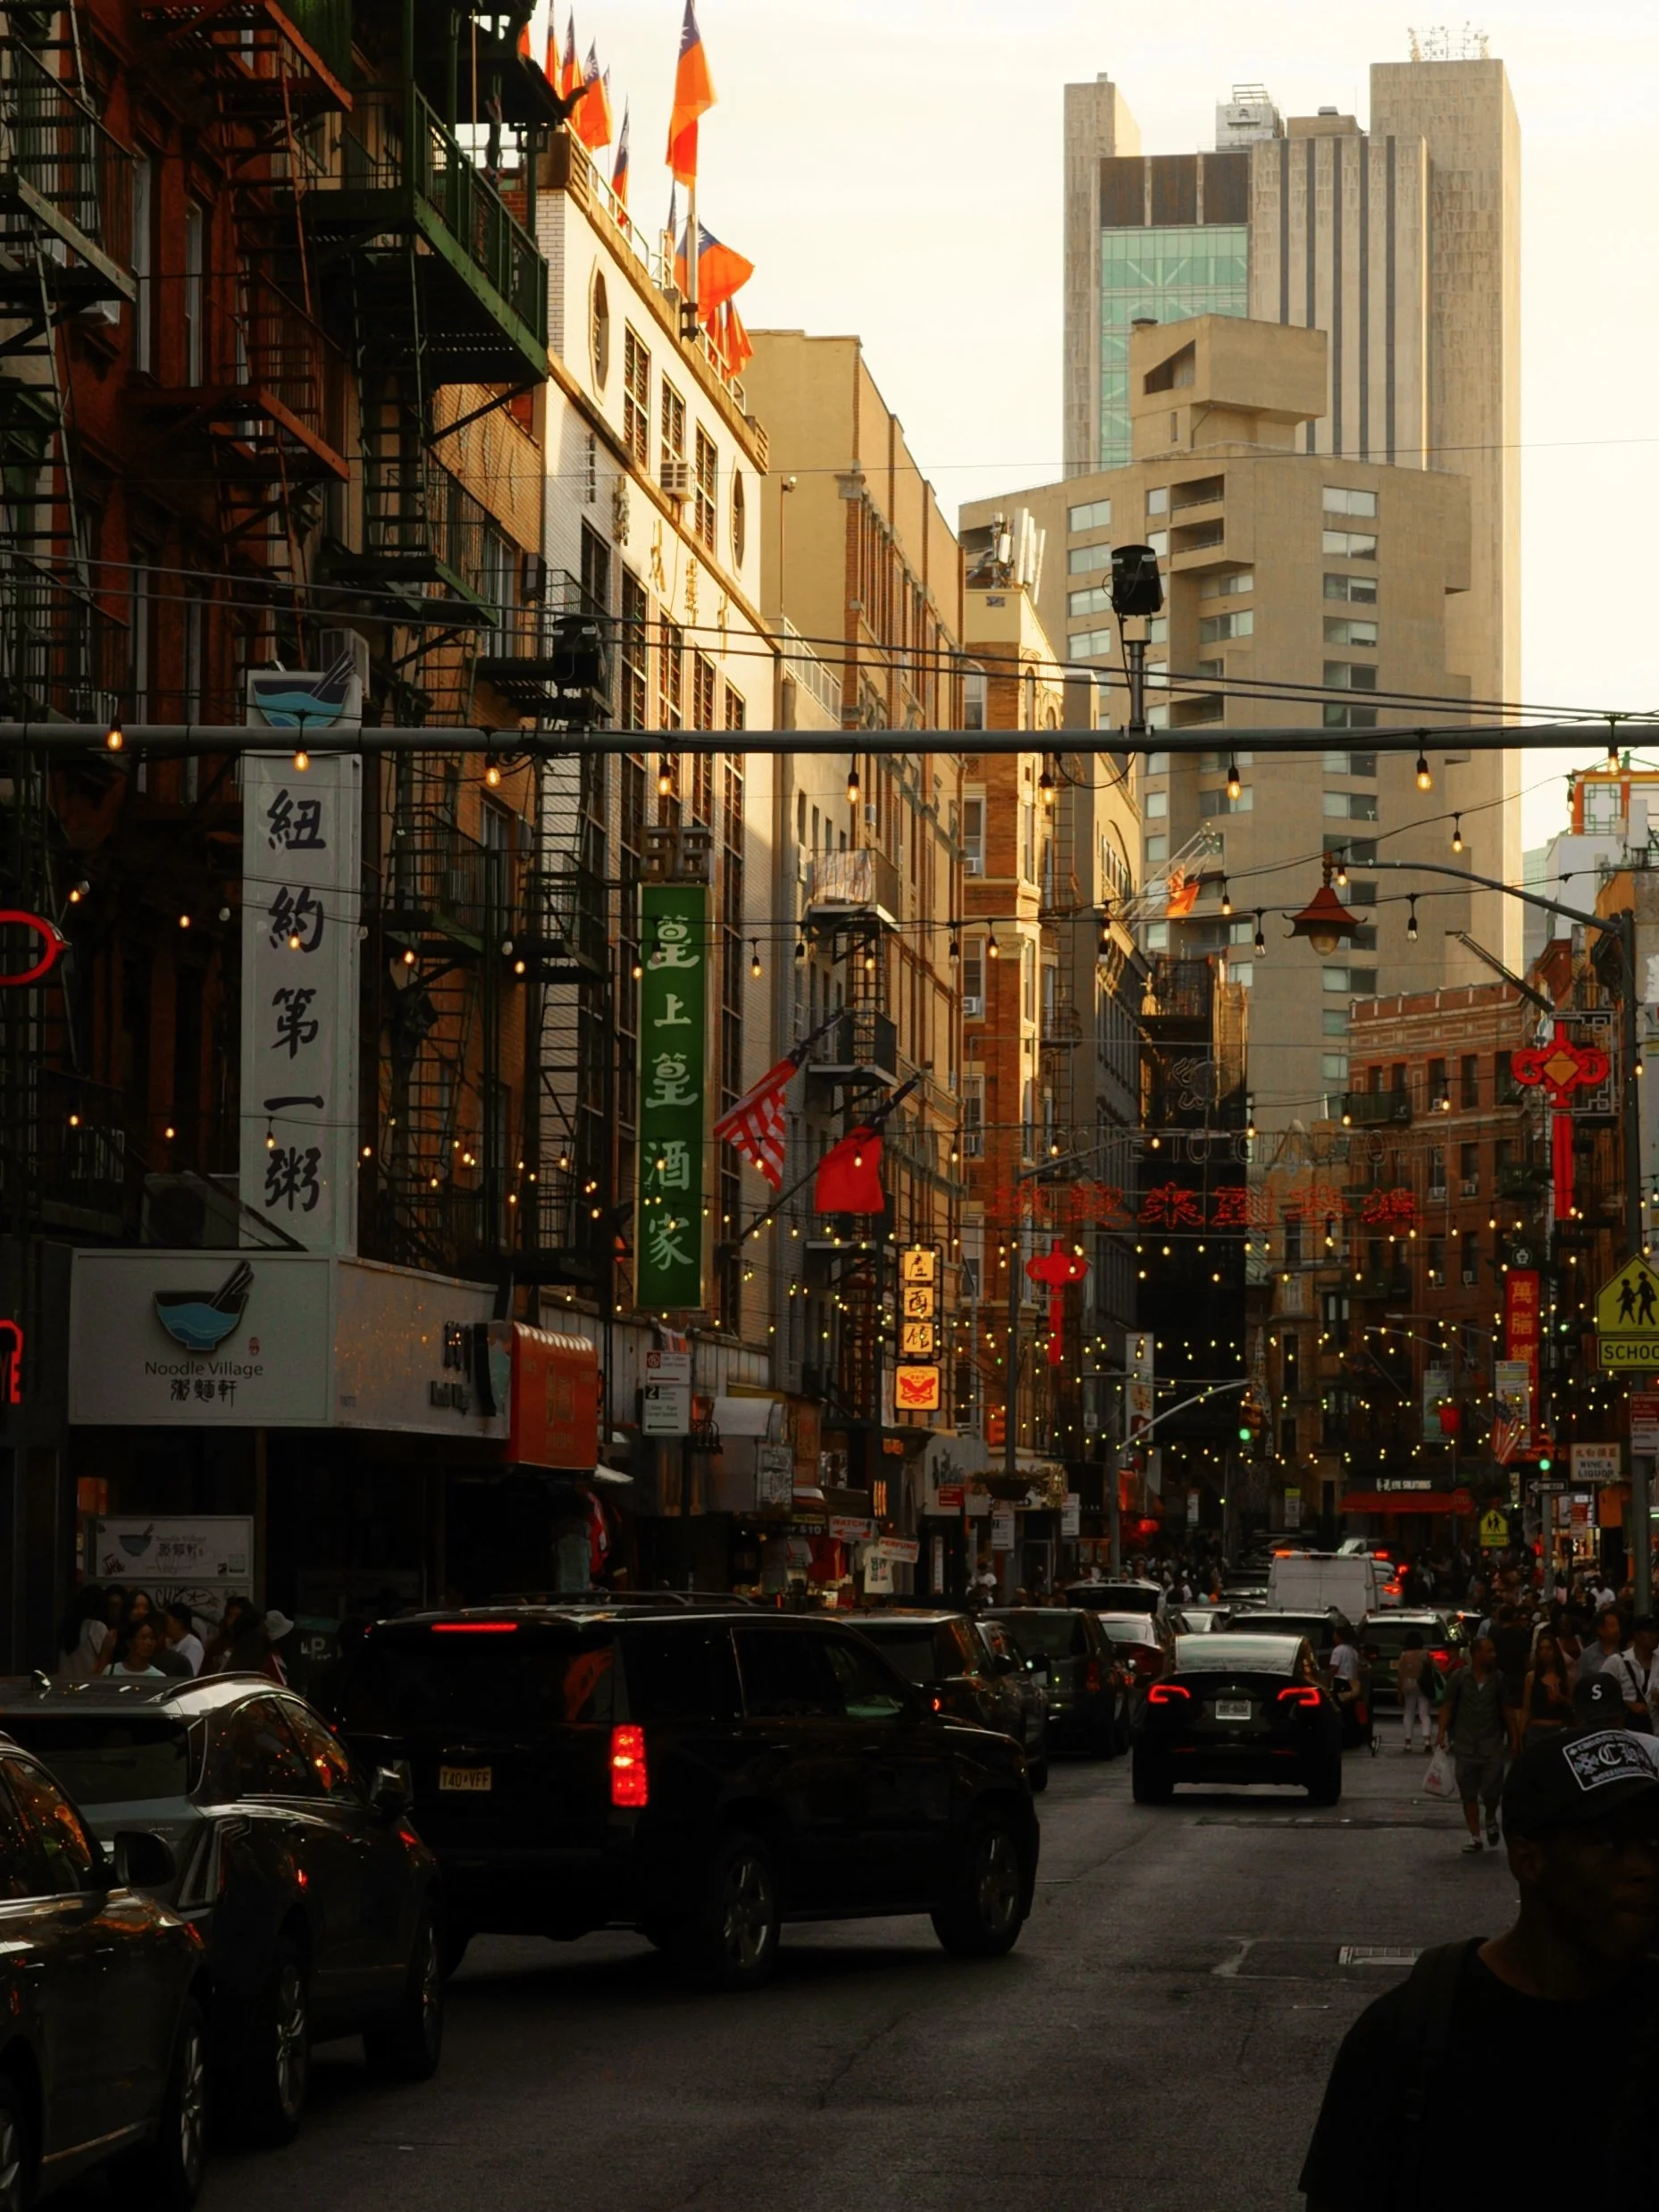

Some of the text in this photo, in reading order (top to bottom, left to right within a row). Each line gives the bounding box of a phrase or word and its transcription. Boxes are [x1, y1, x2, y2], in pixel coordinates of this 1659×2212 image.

[264, 788, 327, 1212] 紐約第一粥
[145, 1361, 264, 1379] Noodle Village
[832, 1518, 867, 1529] WATCH
[1590, 1683, 1604, 1701] S
